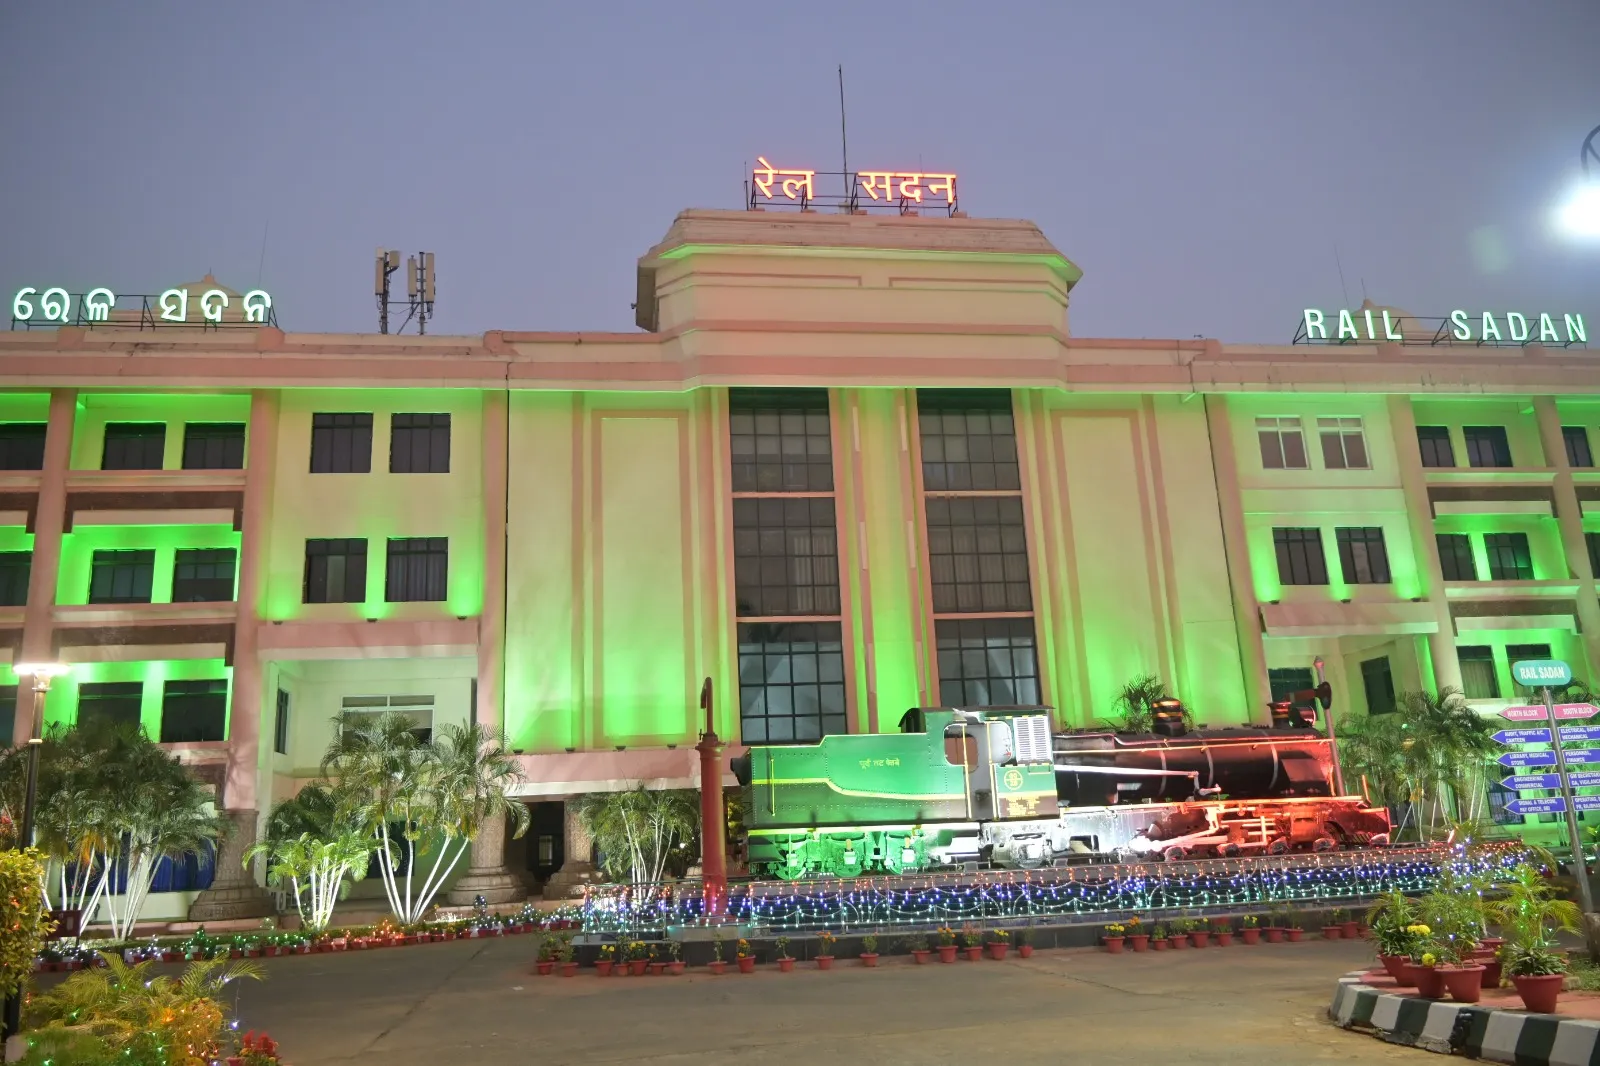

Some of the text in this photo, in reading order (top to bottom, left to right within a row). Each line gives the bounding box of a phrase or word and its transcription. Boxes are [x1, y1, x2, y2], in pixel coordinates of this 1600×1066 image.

[753, 156, 957, 204] रेल सदन
[13, 287, 272, 323] ରେଳ ସଦନ
[1303, 308, 1588, 342] RAIL SADAN
[1520, 666, 1565, 679] RAIL SADAN
[1523, 709, 1538, 717] BLOCK
